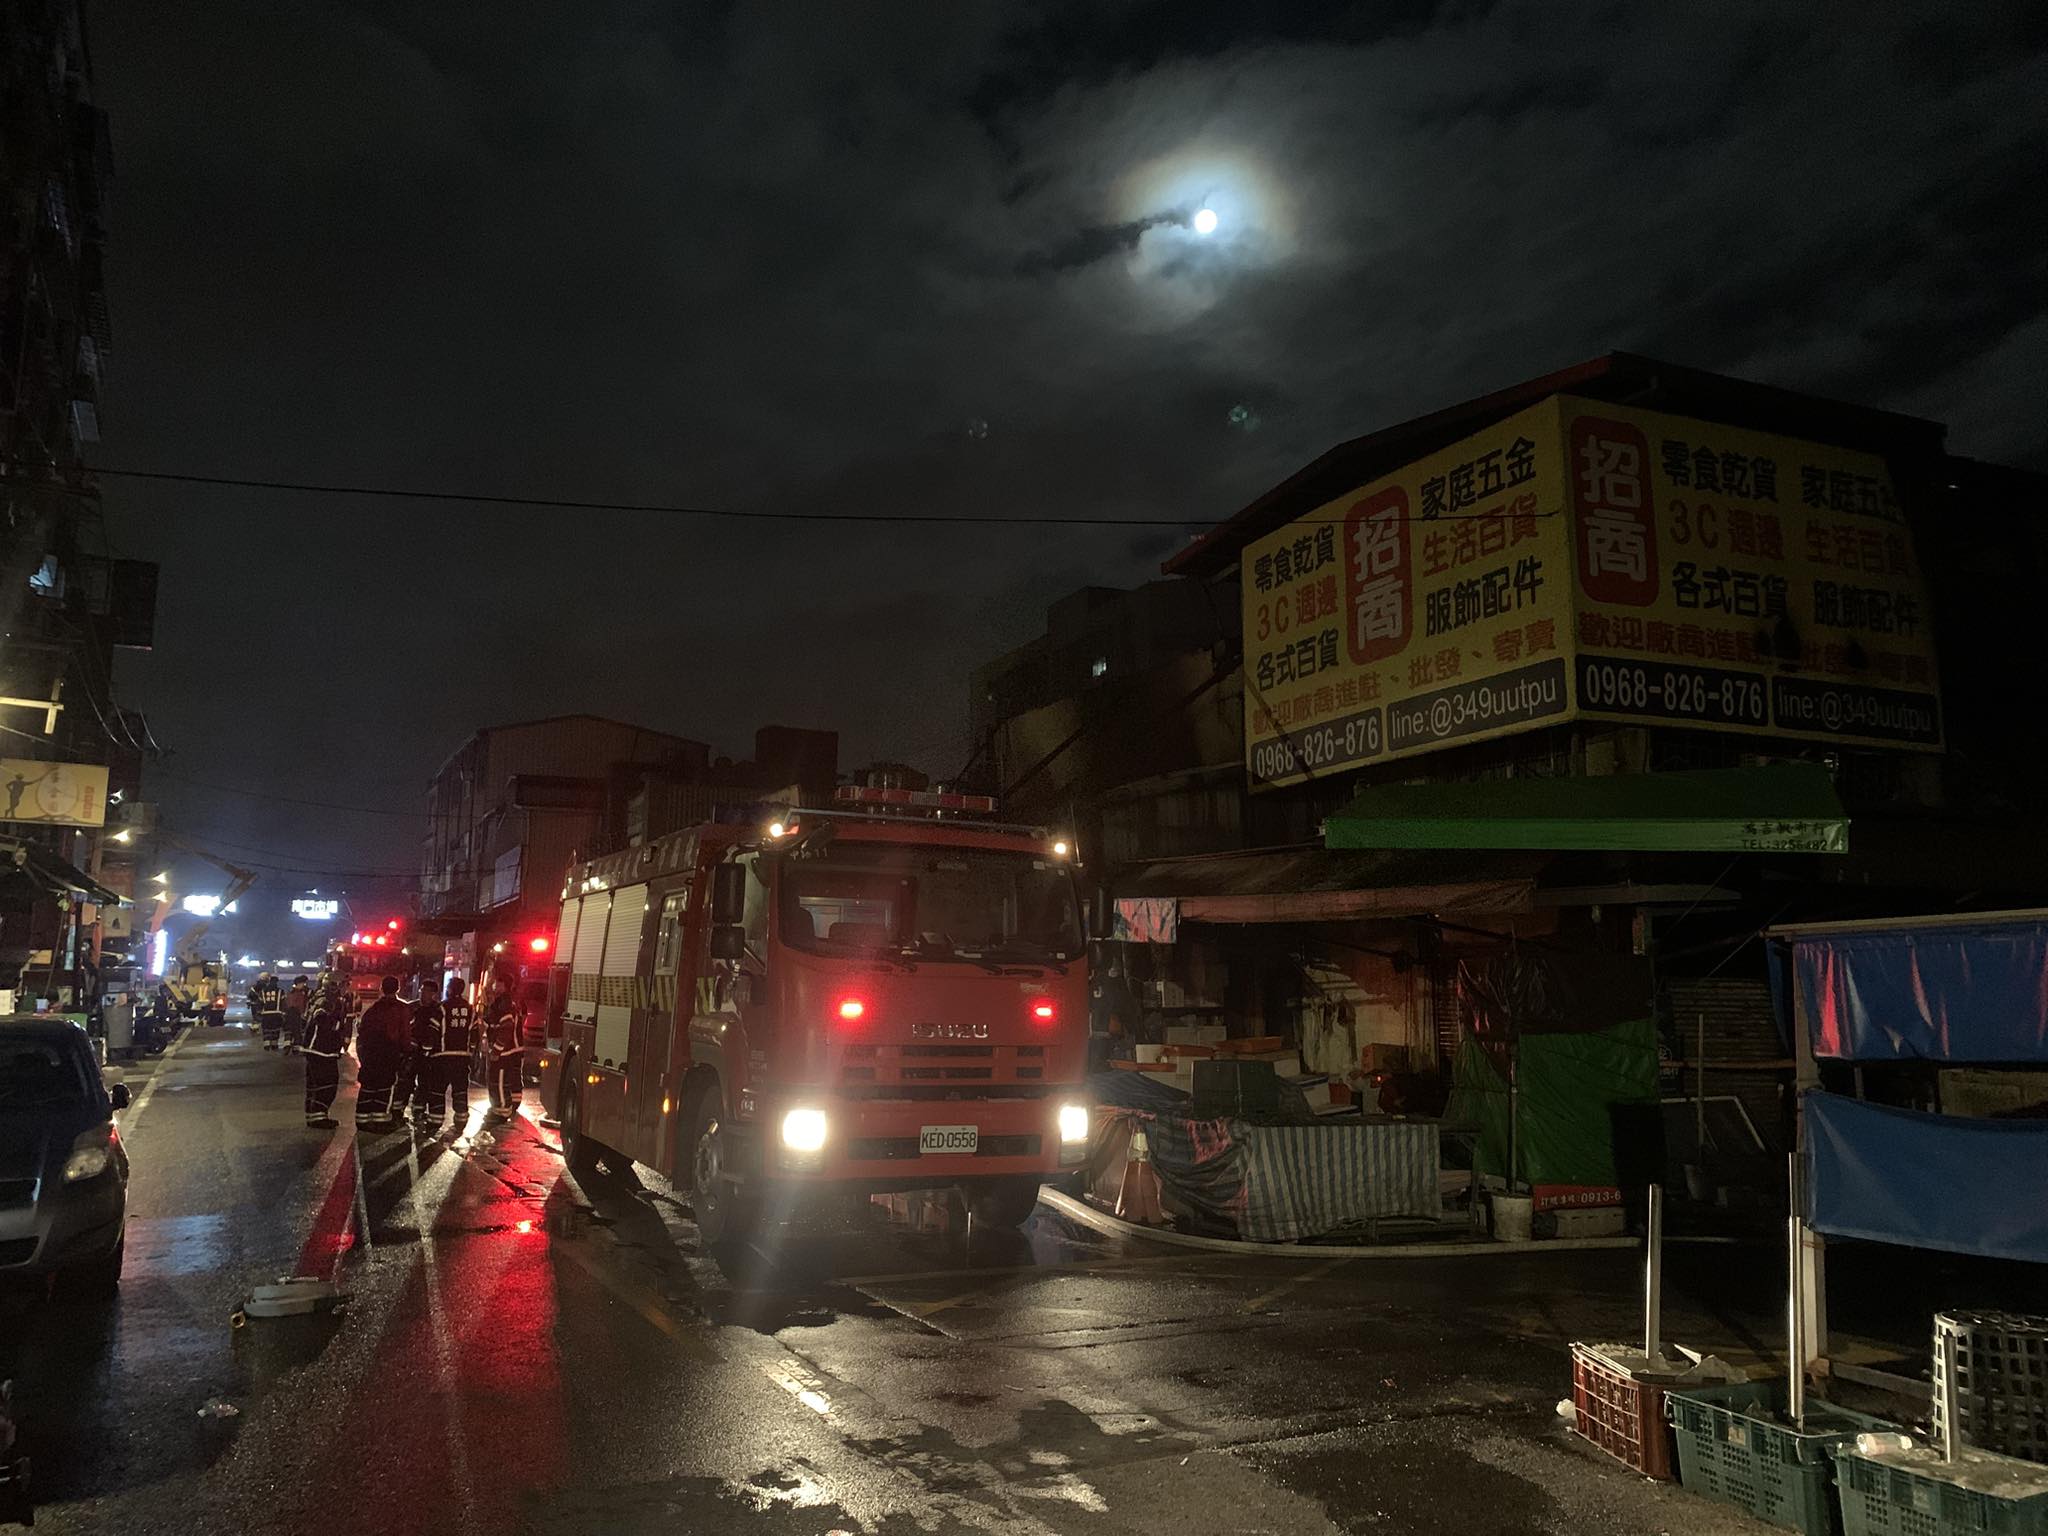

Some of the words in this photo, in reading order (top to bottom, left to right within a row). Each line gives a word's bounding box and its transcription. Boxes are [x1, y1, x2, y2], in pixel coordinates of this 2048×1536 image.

[1421, 436, 1537, 520] 家庭五金
[1662, 439, 1778, 503] 零食乾貨
[1422, 492, 1538, 577] 生活百貨
[1580, 434, 1649, 583] 招商
[1254, 525, 1336, 593] 零食乾貨
[1354, 505, 1404, 650] 招商
[1672, 562, 1788, 620] 各式百貨
[1426, 555, 1543, 637] 服飾配件
[1256, 628, 1339, 691] 各式百貨
[1392, 677, 1557, 738] line:@349uutpu
[1585, 663, 1764, 721] 0968-826-876
[1256, 715, 1379, 779] 0968-826-876
[921, 1132, 977, 1149] KED-0558
